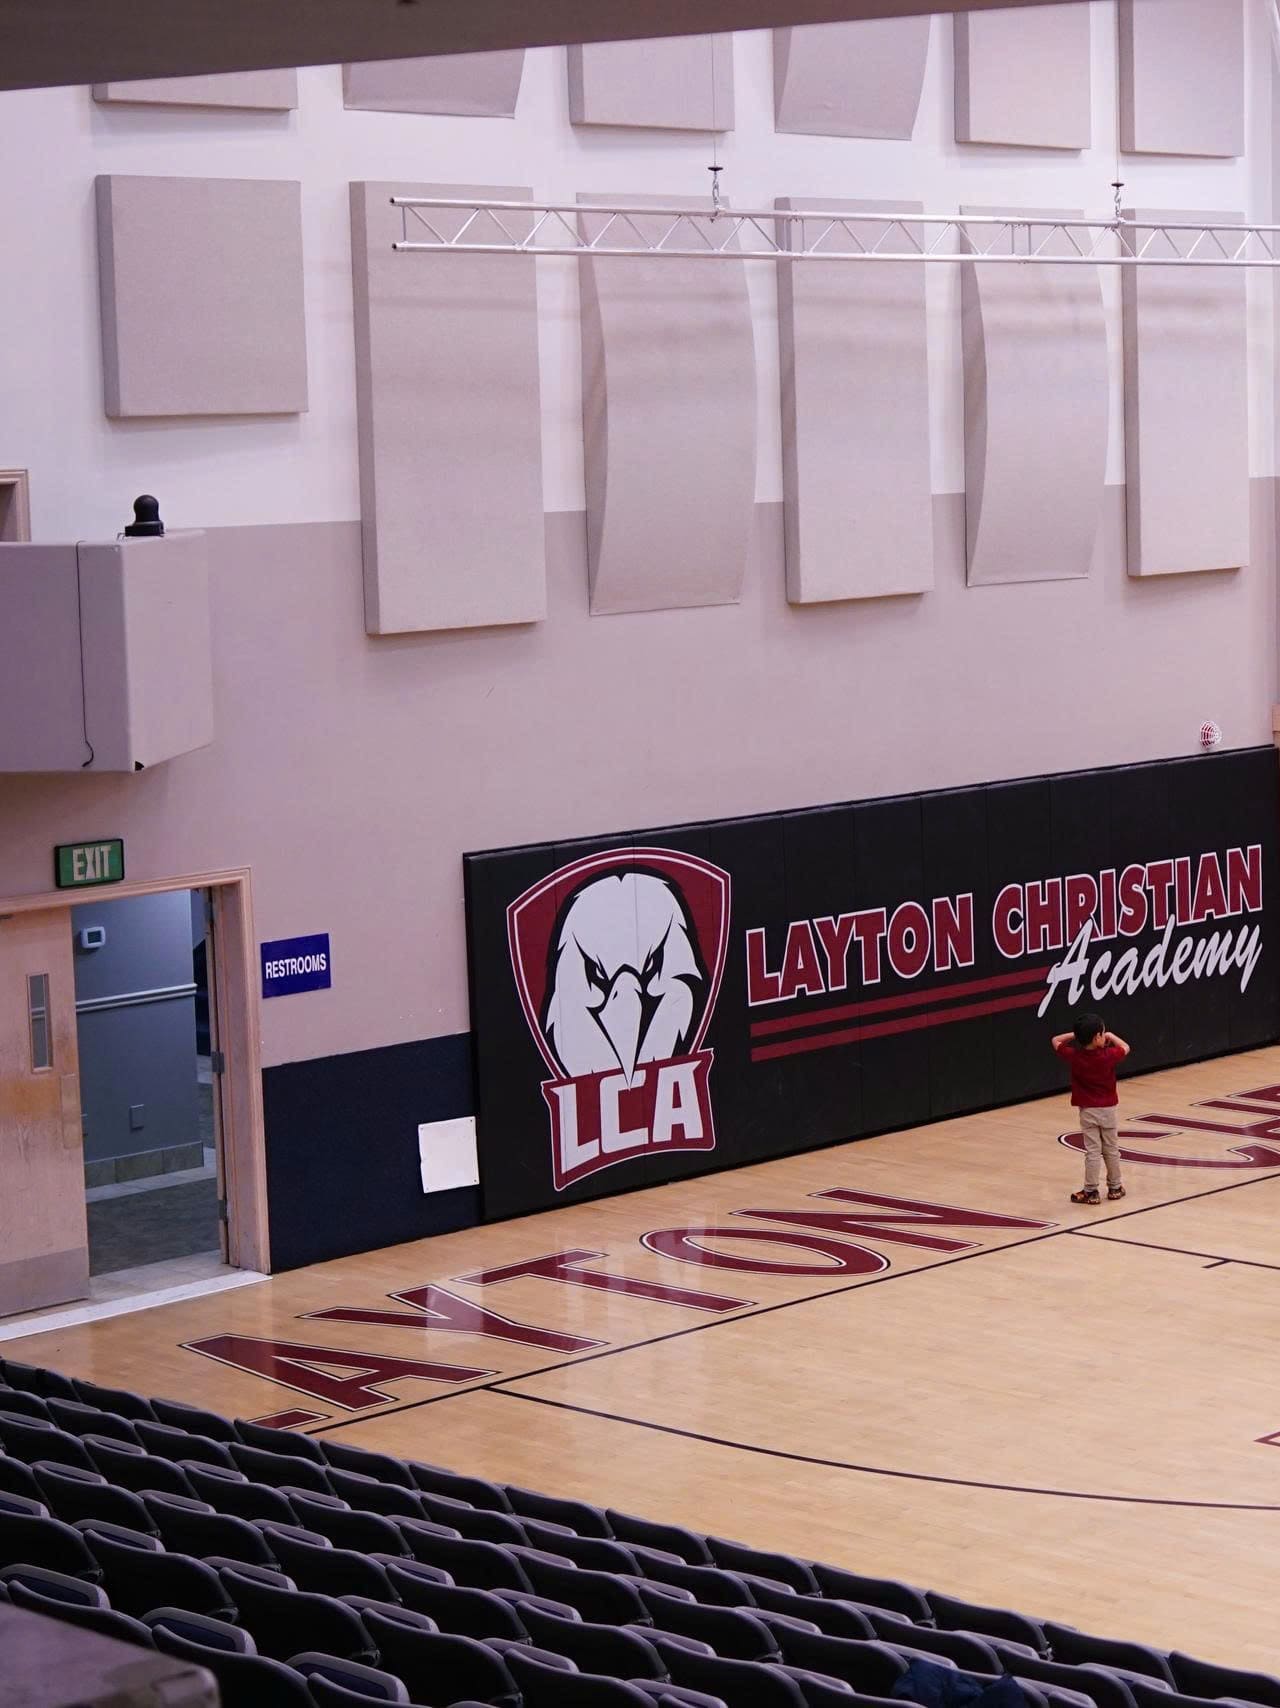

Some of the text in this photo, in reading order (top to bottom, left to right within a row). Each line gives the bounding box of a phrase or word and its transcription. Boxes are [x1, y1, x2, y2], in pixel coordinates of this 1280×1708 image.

[72, 845, 112, 881] EXIT
[265, 953, 327, 979] RESTROOMS
[745, 844, 1263, 1007] LAYTON CHRISTIAN
[1037, 914, 1263, 1018] Academy
[549, 1060, 705, 1175] LCA
[179, 1187, 1061, 1431] AYTON
